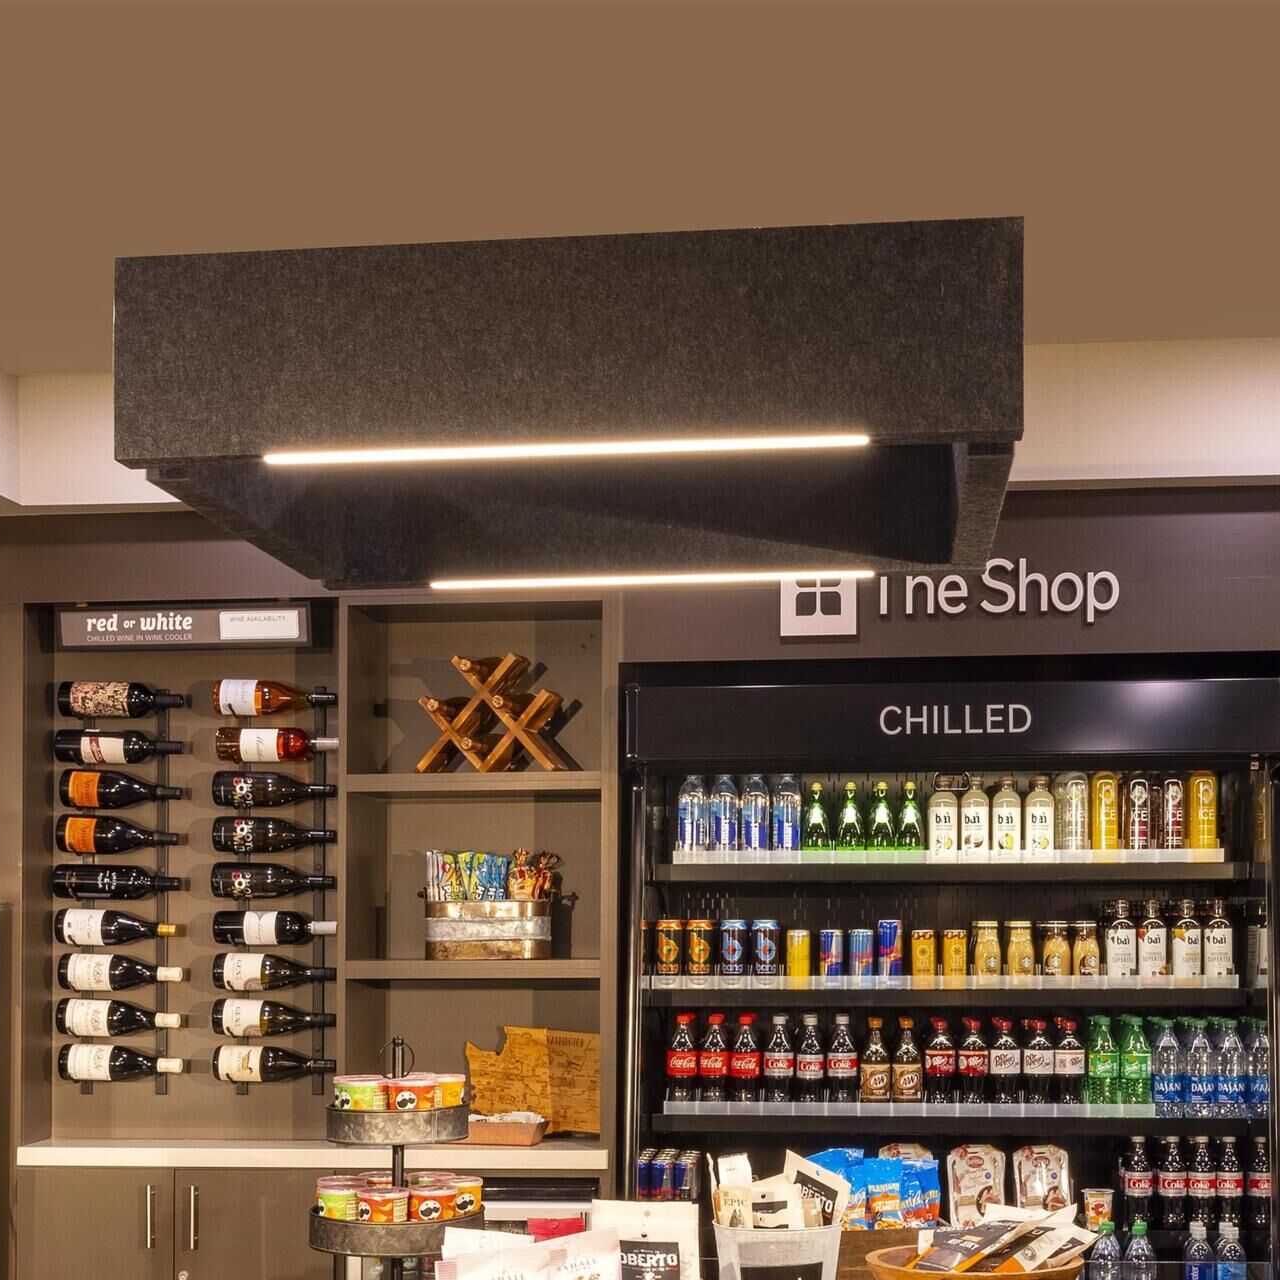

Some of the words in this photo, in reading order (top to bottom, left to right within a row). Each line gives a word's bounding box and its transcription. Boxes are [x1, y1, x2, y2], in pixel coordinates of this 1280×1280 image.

[980, 557, 1120, 623] Shop
[86, 613, 118, 632] red
[123, 619, 136, 629] or
[140, 611, 192, 631] white
[879, 704, 1032, 735] CHILLED
[768, 1059, 788, 1069] Coke
[800, 1061, 821, 1072] Coke
[831, 1059, 851, 1069] Coke
[1130, 1179, 1152, 1189] Coke
[1164, 1179, 1186, 1189] Coke
[1189, 1179, 1210, 1189] Coke
[1216, 1179, 1237, 1189] Coke
[723, 1198, 748, 1207] EPIC
